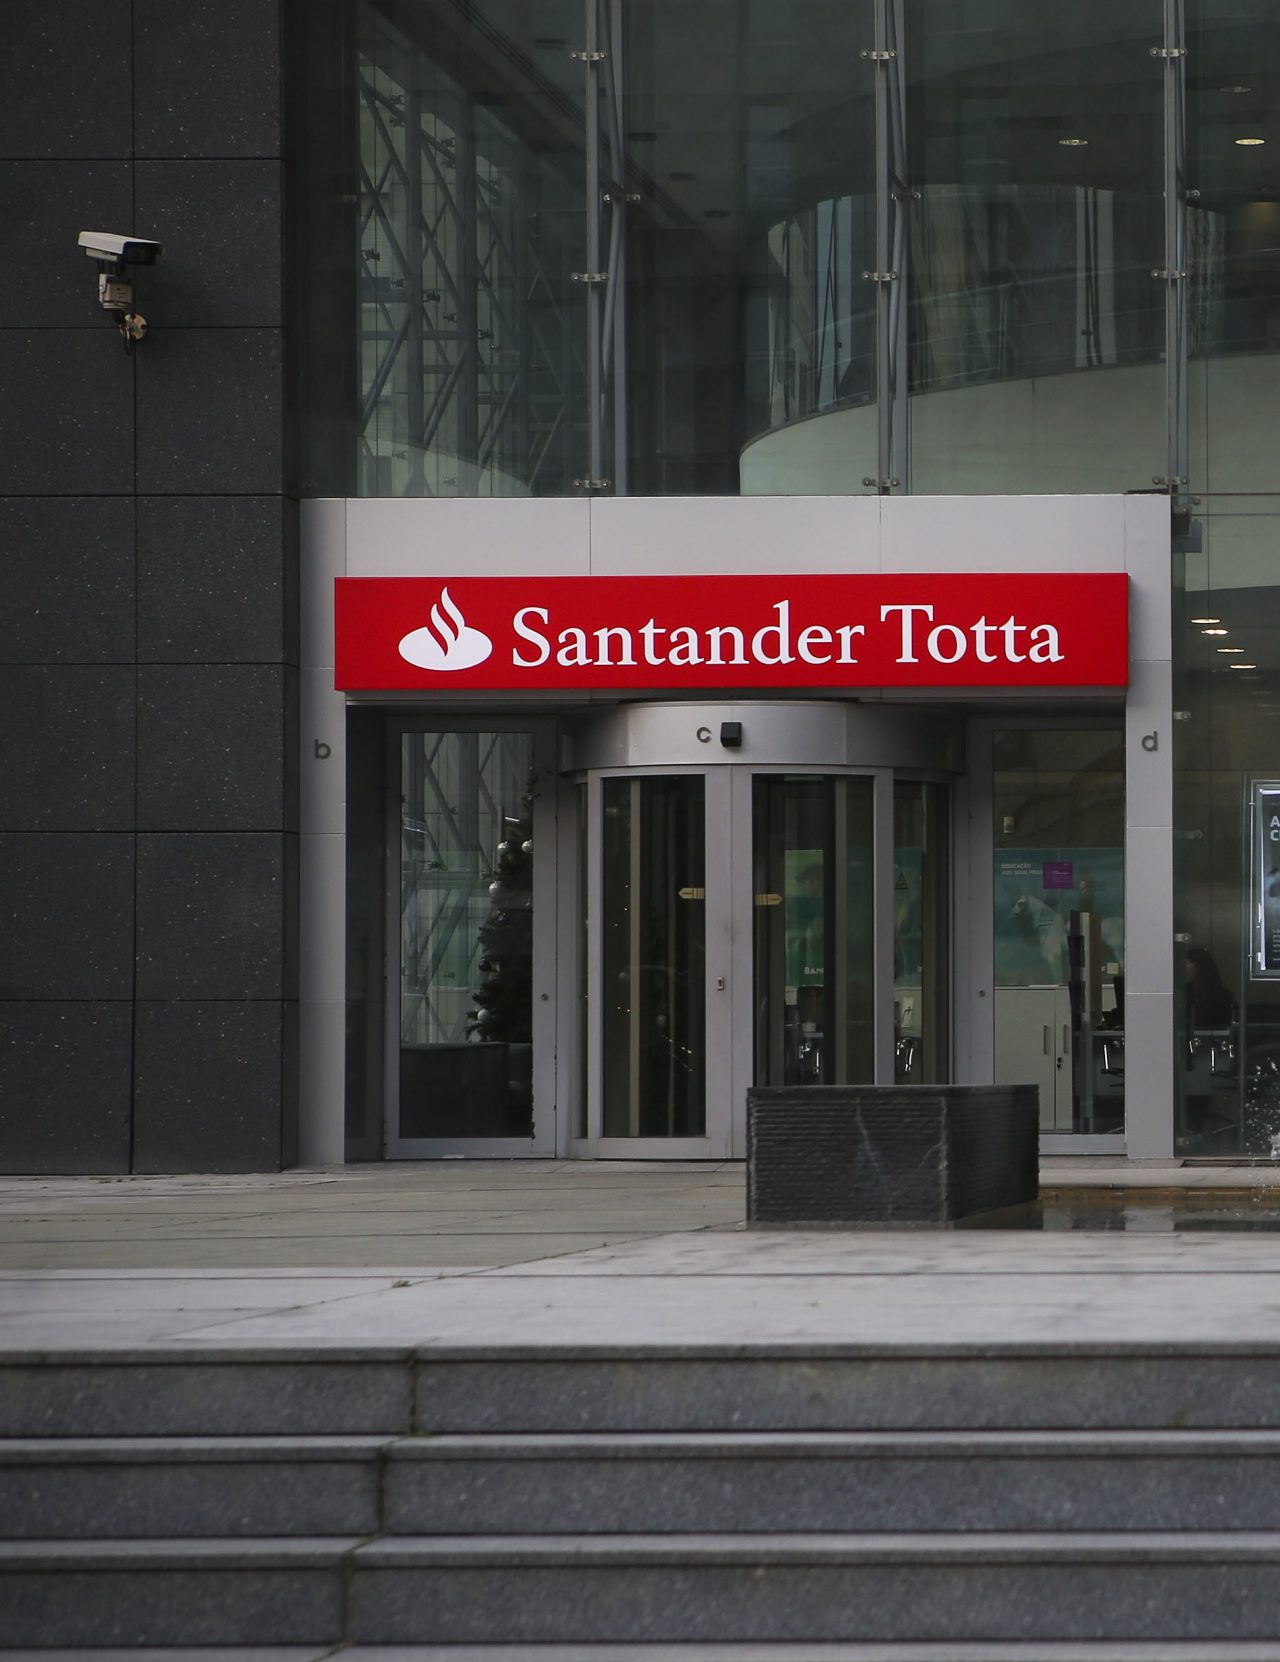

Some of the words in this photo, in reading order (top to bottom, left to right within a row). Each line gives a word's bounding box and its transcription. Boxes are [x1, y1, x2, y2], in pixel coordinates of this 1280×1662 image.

[512, 600, 864, 667] Santander
[881, 604, 1065, 664] Totta
[696, 726, 713, 743] c
[1141, 730, 1158, 752] d
[314, 739, 331, 760] b
